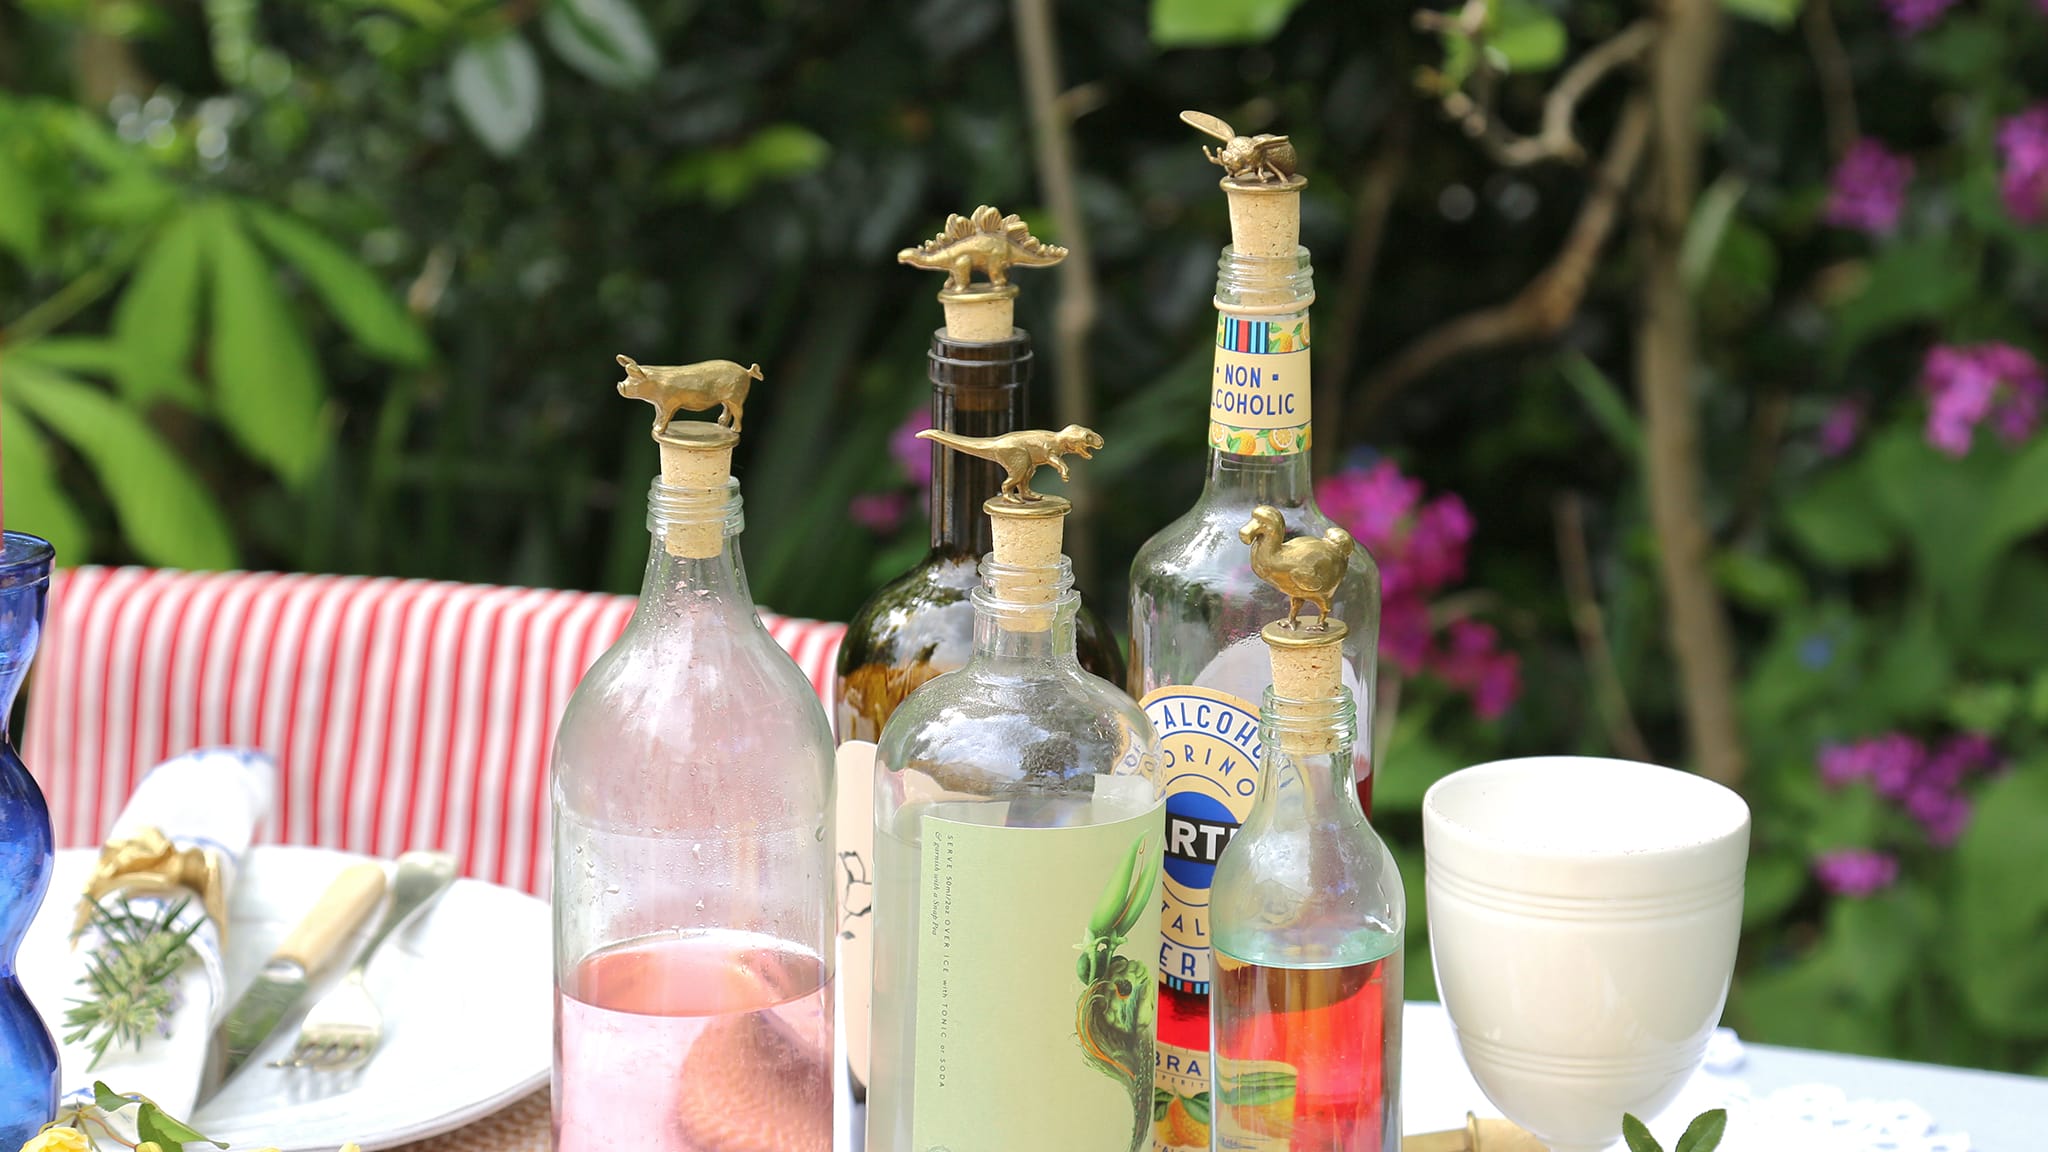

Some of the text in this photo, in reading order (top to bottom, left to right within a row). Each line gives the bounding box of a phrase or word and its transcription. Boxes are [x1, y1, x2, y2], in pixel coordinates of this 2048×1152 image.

[1225, 363, 1261, 388] NON
[1212, 388, 1295, 416] COHOLIC
[931, 900, 940, 920] Snap
[943, 919, 952, 948] OVER
